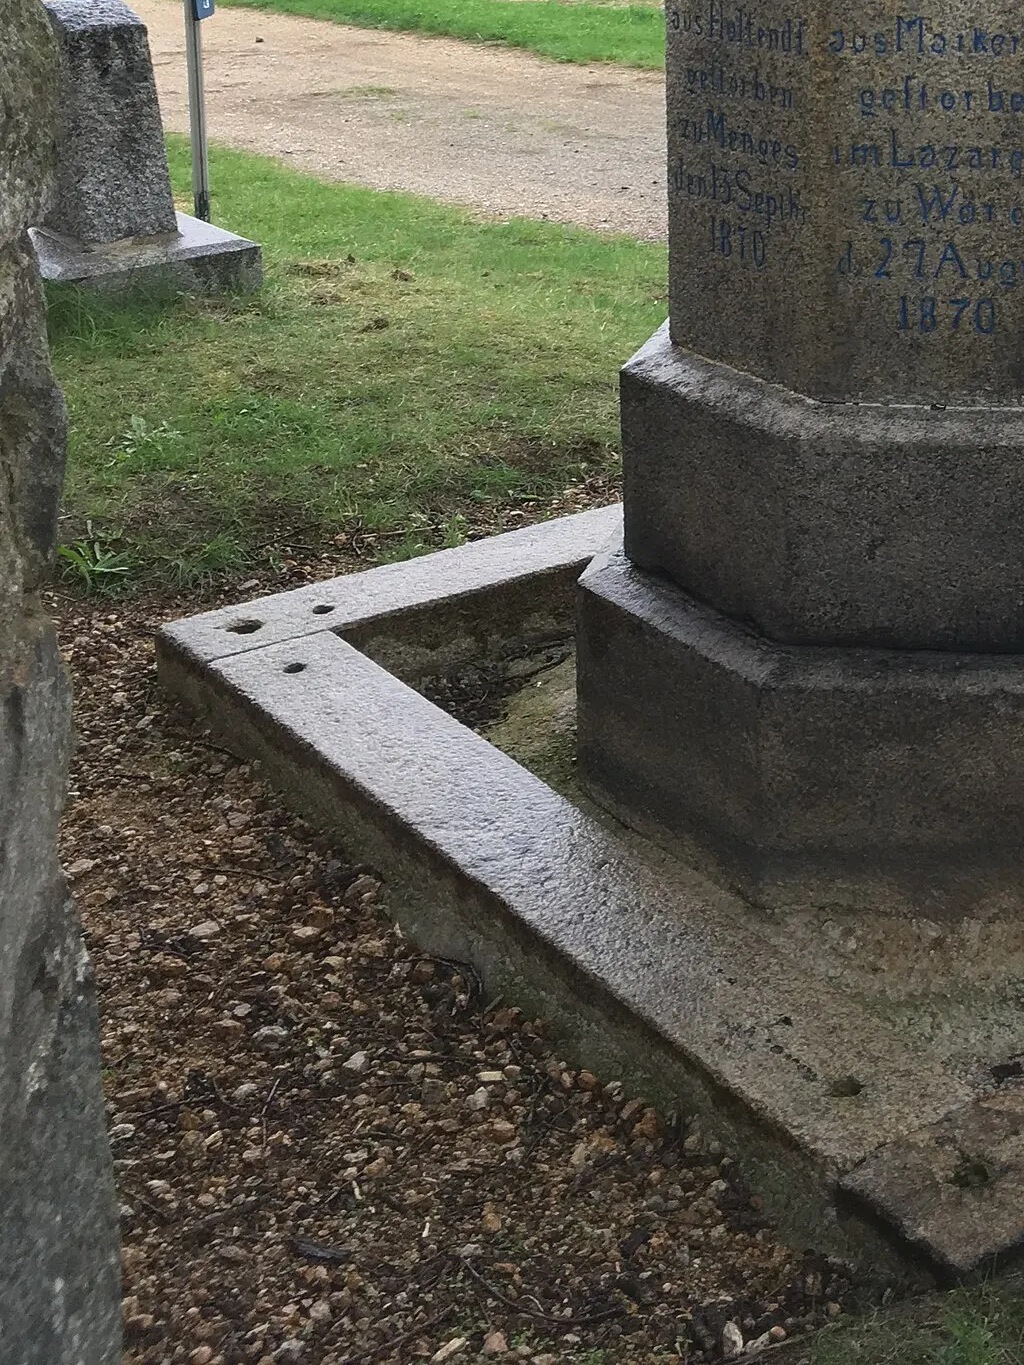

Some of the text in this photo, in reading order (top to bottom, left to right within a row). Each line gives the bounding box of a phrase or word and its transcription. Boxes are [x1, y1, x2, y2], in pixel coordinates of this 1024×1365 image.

[828, 31, 888, 54] aus
[833, 143, 880, 167] im
[861, 198, 901, 223] zu
[874, 238, 925, 279] 27
[900, 296, 996, 335] 1870
